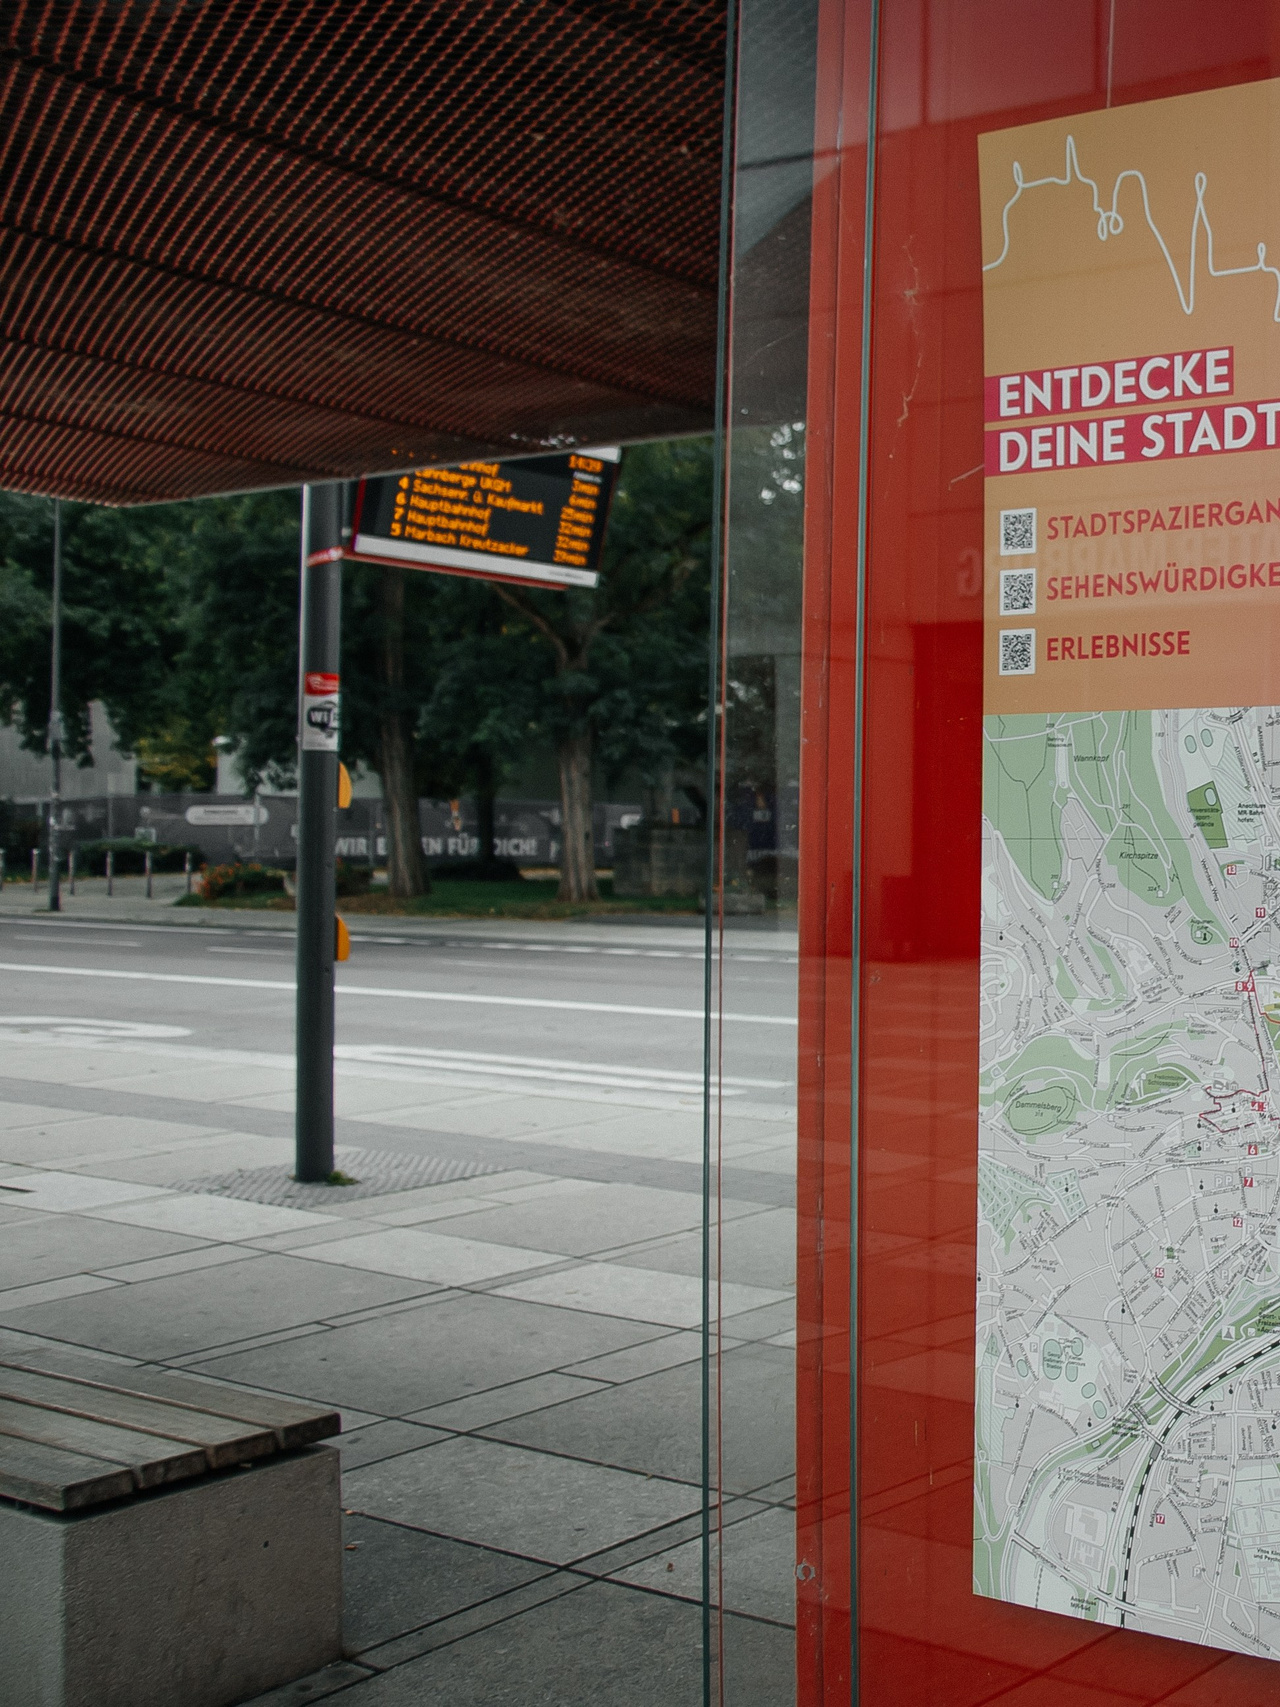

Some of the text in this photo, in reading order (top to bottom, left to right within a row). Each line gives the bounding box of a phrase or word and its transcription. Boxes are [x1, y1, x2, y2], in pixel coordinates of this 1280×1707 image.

[999, 349, 1230, 417] ENTDECKE
[1000, 419, 1125, 472] DEINE
[1047, 631, 1190, 661] ERLEBNISSE
[1119, 852, 1158, 861] Kirchspitze
[1016, 1101, 1061, 1113] Dammelsberg
